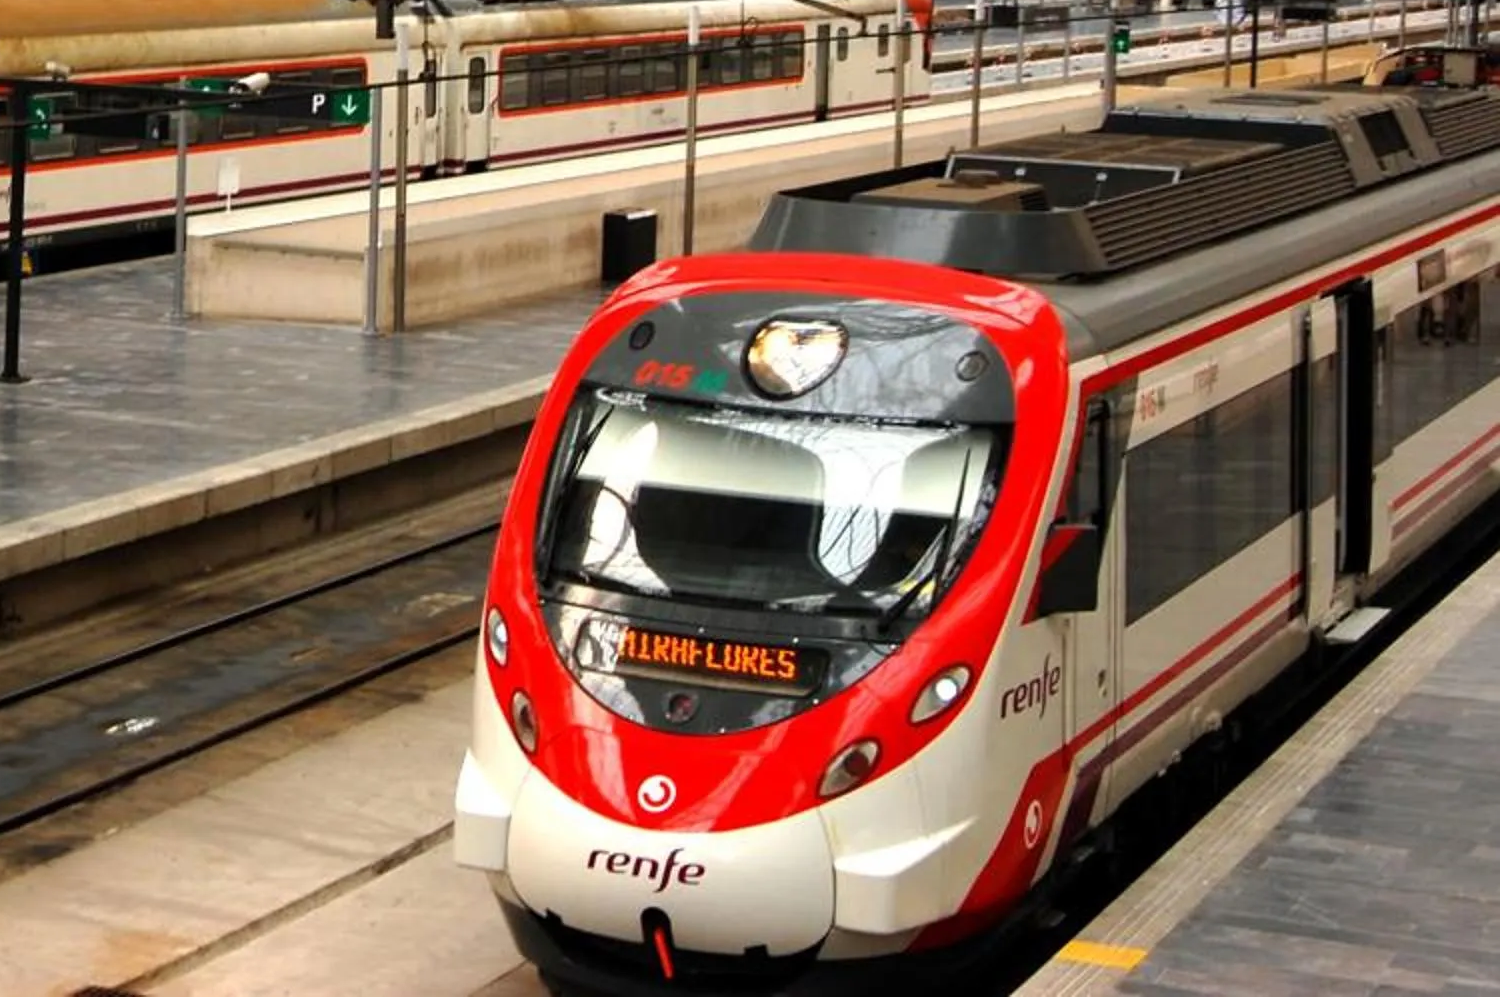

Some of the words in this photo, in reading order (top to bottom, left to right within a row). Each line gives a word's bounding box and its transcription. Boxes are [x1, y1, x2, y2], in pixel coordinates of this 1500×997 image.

[312, 94, 326, 114] P
[1001, 652, 1060, 720] renfe
[587, 847, 705, 893] renfe
